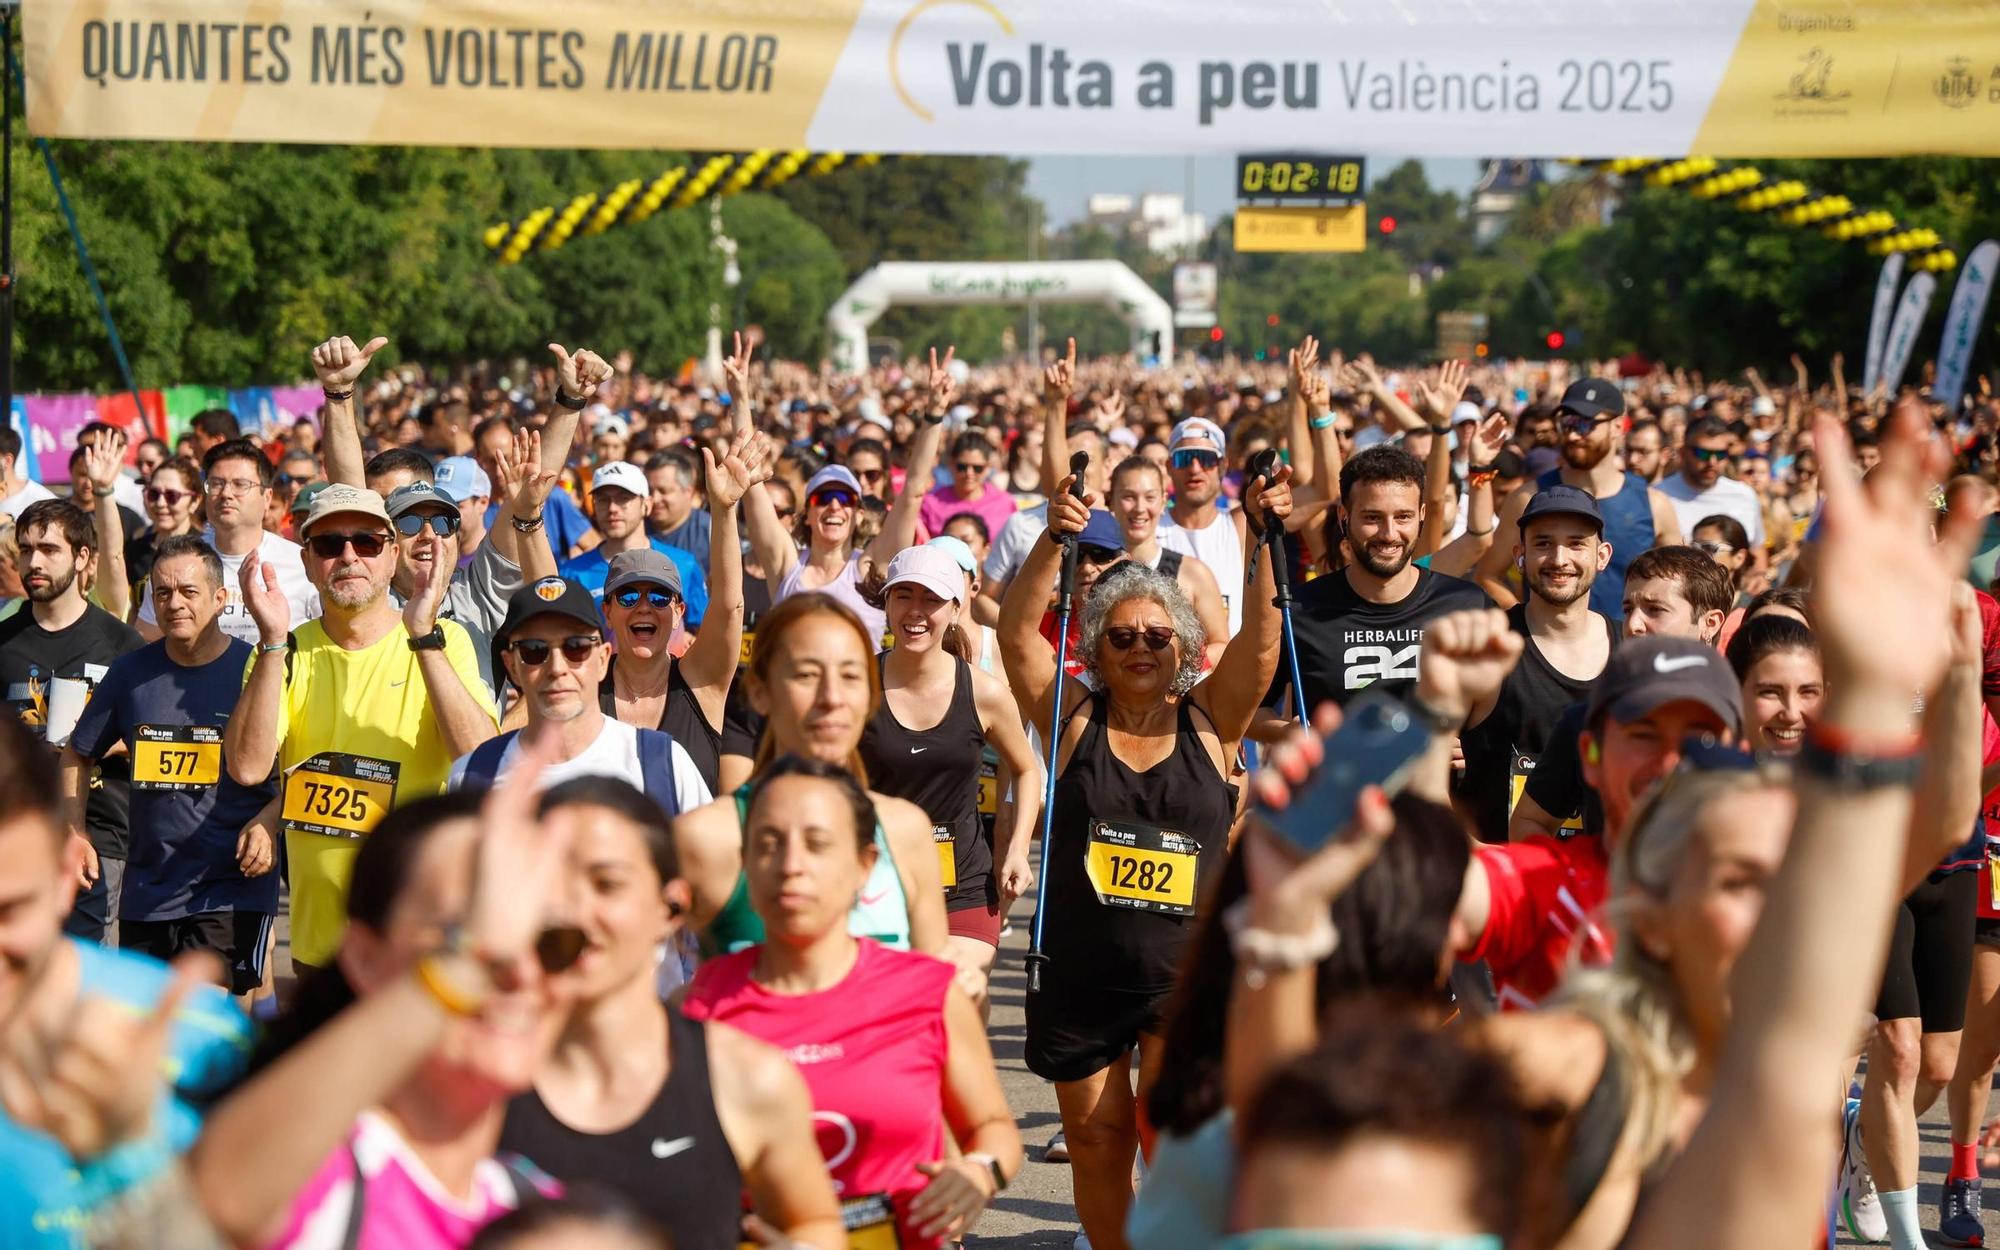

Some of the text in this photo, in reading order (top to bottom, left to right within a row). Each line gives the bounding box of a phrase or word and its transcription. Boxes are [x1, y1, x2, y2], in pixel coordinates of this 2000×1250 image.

[82, 9, 778, 93] QUANTES MÉS VOLTES MILLOR
[946, 41, 1674, 125] Volta a peu València 2025
[1243, 161, 1360, 193] 0:02:18
[160, 750, 199, 776] 577
[1523, 760, 1536, 768] Volt
[304, 782, 369, 822] 7325
[1101, 828, 1117, 837] Volta
[1110, 856, 1173, 894] 1282
